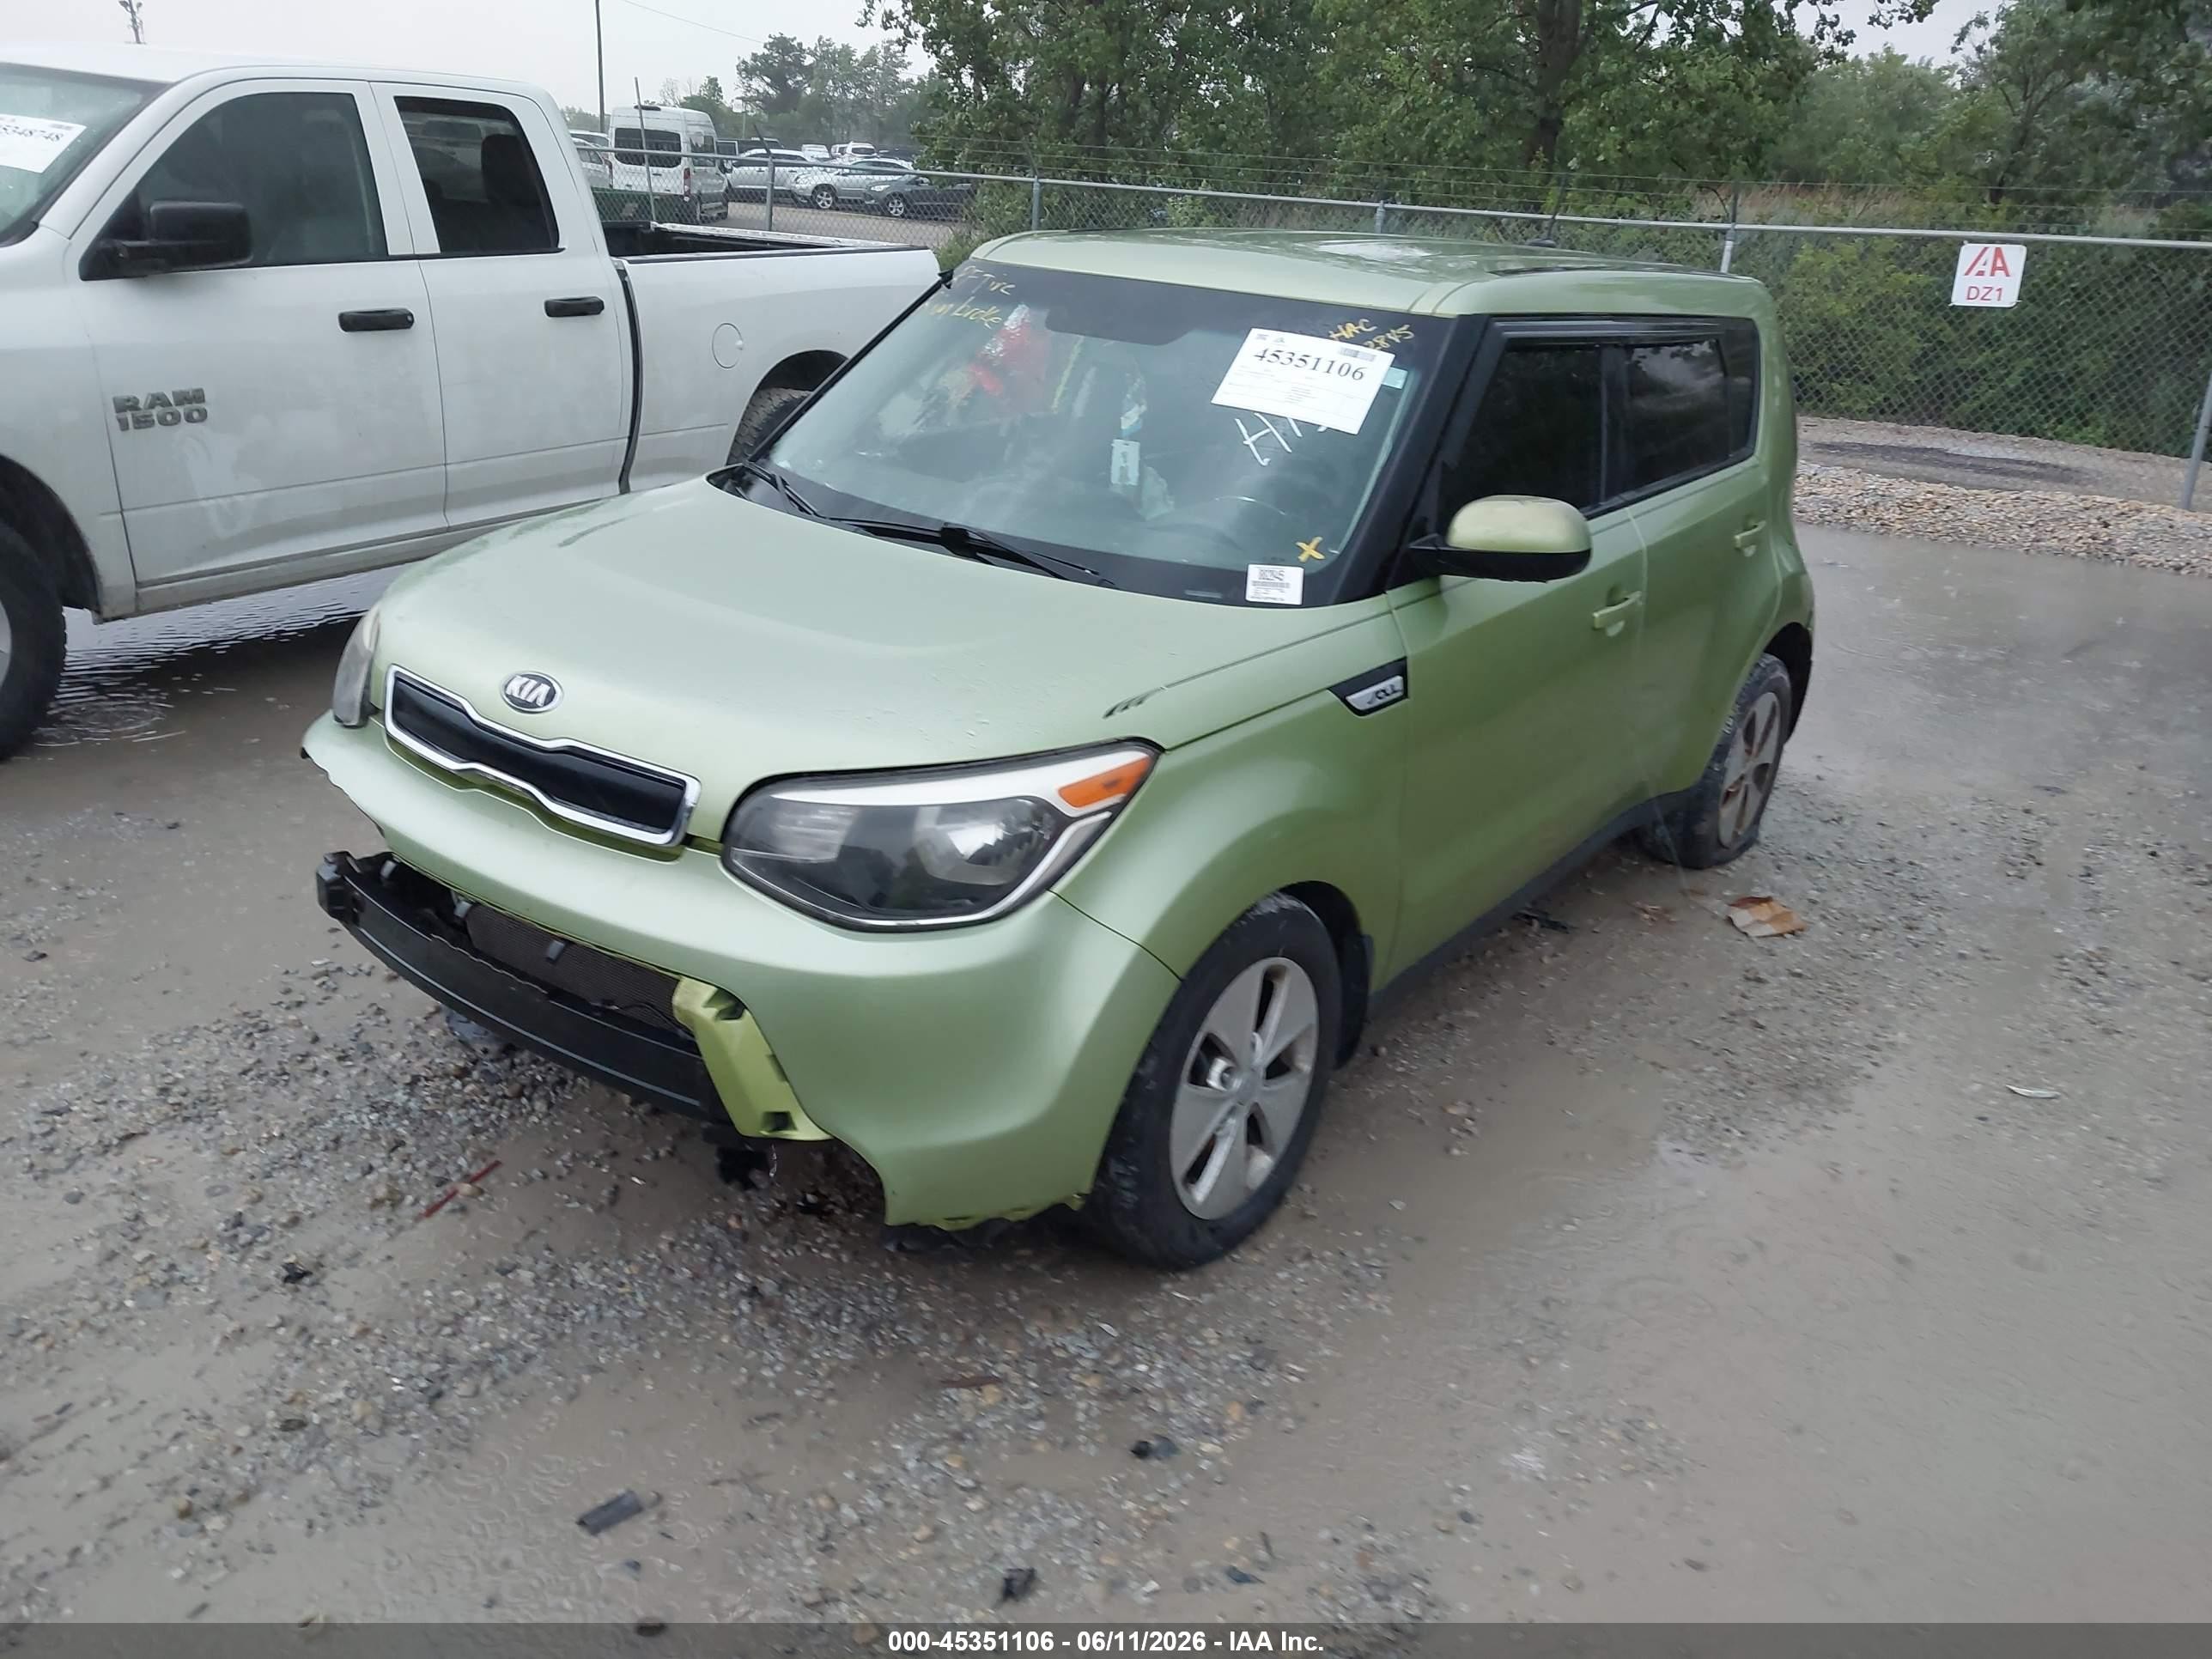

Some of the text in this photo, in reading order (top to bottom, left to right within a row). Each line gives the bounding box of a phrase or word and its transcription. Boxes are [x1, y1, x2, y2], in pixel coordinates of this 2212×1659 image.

[1966, 286, 2003, 302] DZ1
[1253, 347, 1368, 381] 45351106
[112, 387, 206, 413] RAM
[116, 404, 208, 431] 1500
[505, 674, 551, 708] KIA
